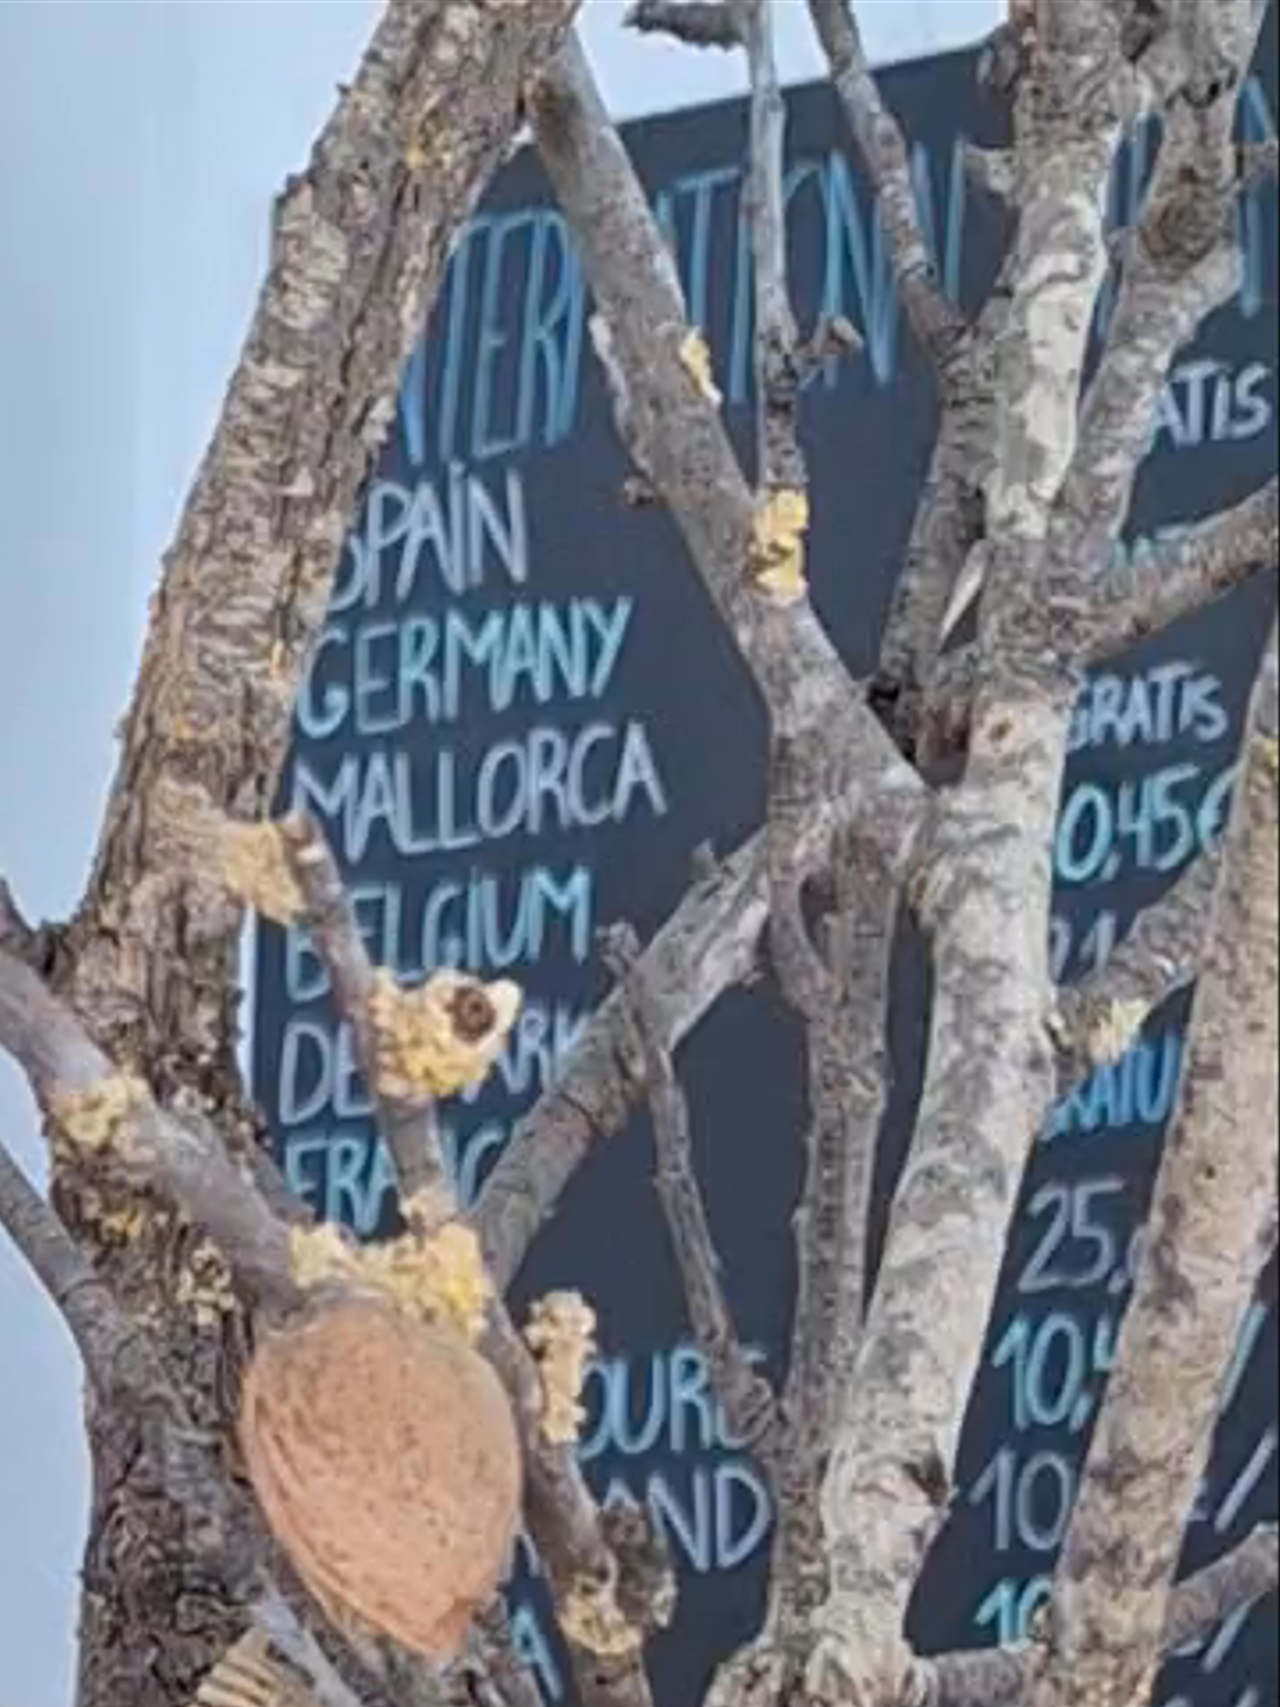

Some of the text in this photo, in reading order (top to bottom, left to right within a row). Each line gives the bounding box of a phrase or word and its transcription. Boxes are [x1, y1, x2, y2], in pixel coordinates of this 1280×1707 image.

[297, 596, 632, 738] GERMANY
[293, 720, 667, 864] MALLORCA
[287, 866, 593, 1000] BELGIUM
